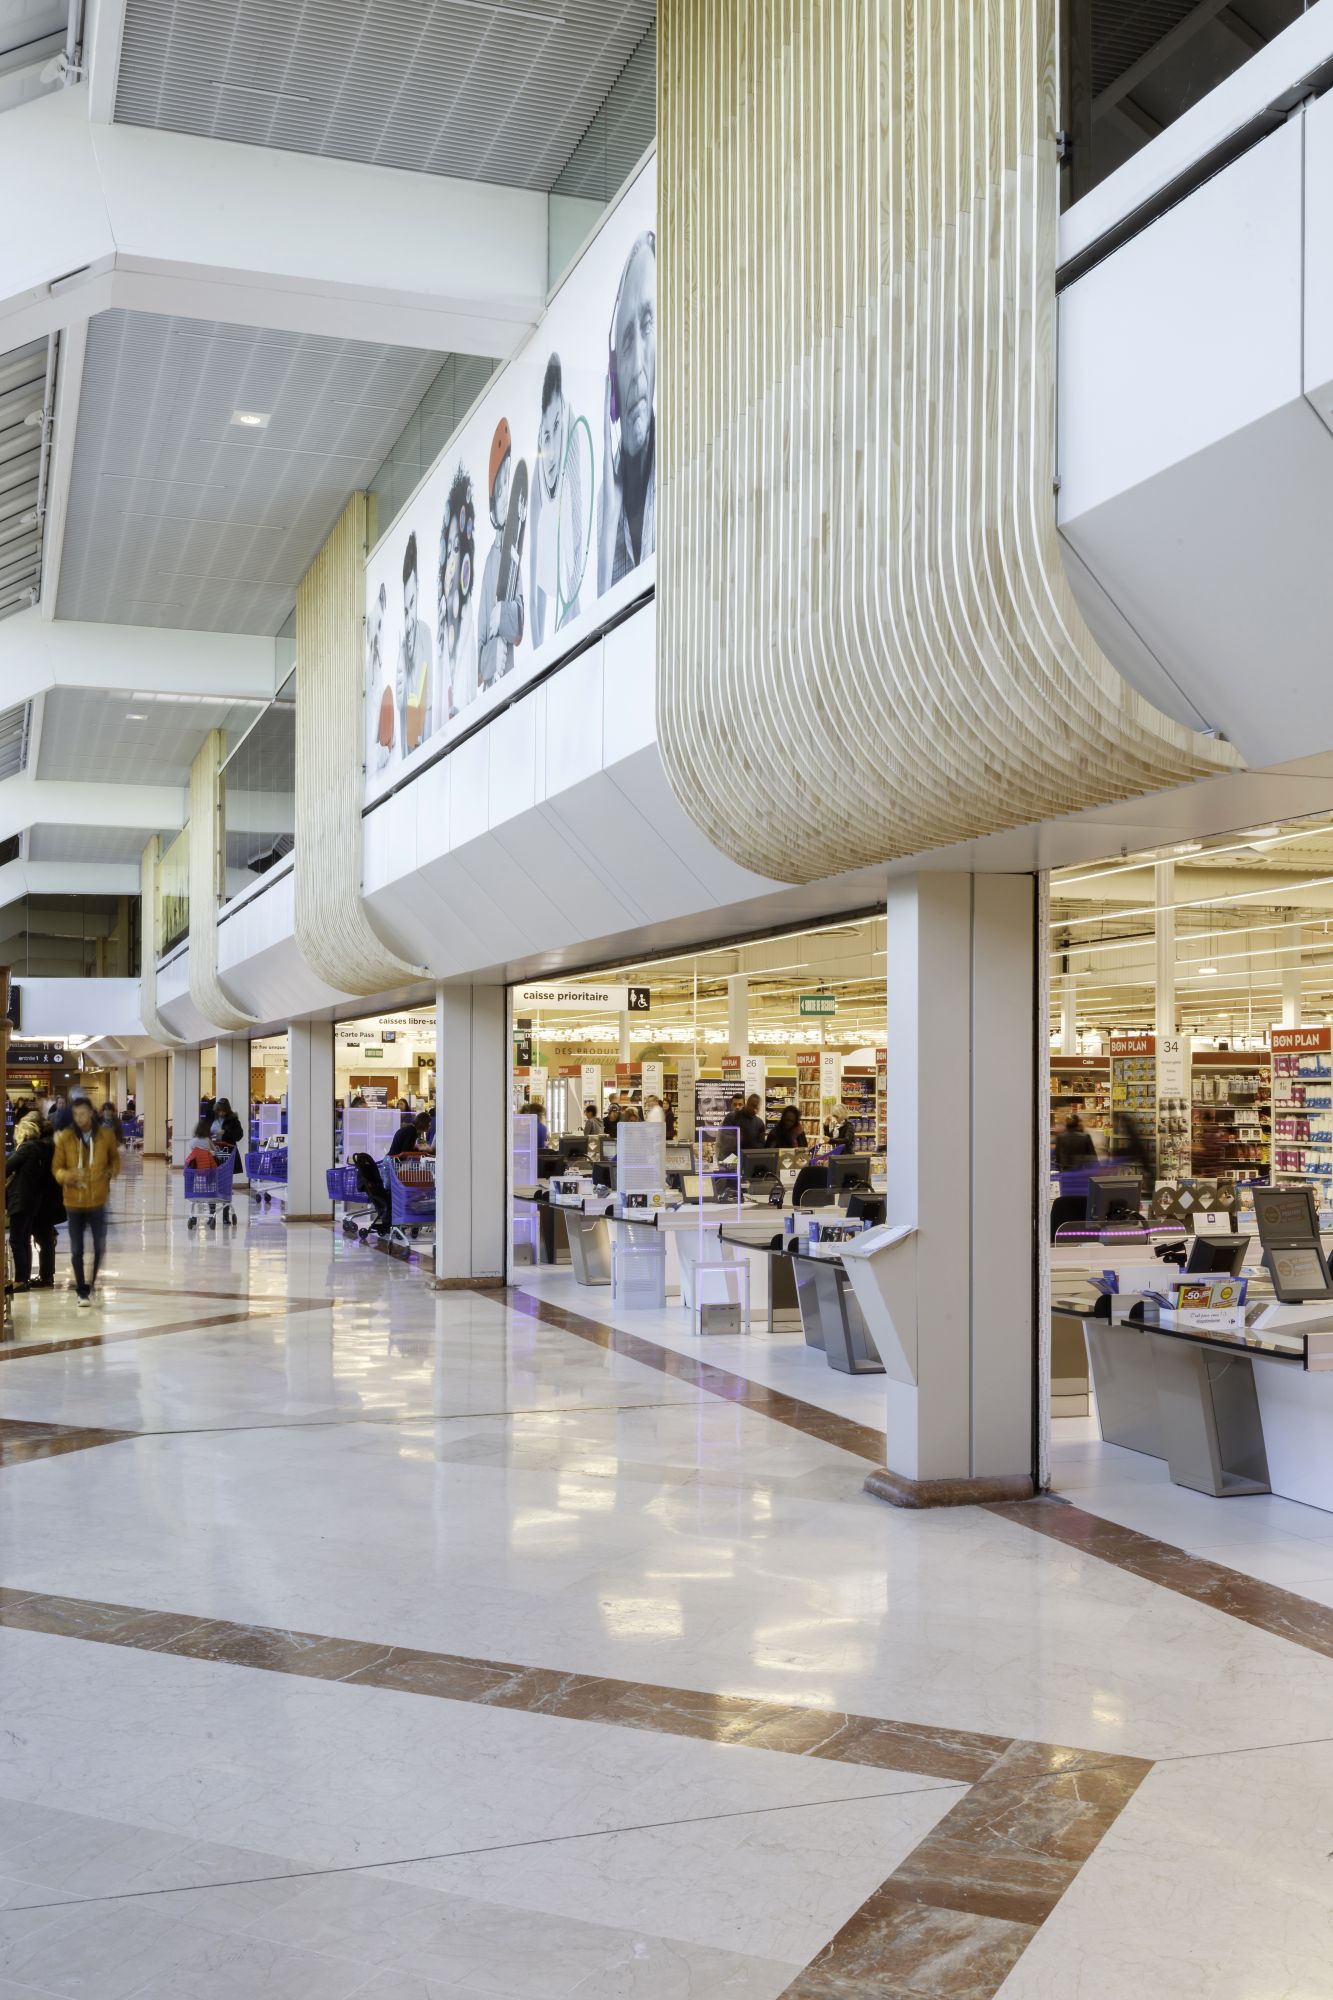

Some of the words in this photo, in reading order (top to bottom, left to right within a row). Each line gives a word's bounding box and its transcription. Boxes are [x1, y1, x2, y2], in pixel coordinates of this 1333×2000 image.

[523, 991, 555, 1000] caisse
[557, 992, 609, 1001] prioritaire
[1273, 1035, 1293, 1047] BON
[1295, 1034, 1320, 1046] PLAN
[1112, 1042, 1126, 1052] BON
[1128, 1041, 1147, 1051] PLAN
[1163, 1041, 1179, 1053] 34
[746, 1059, 757, 1068] 26
[824, 1057, 834, 1065] 28
